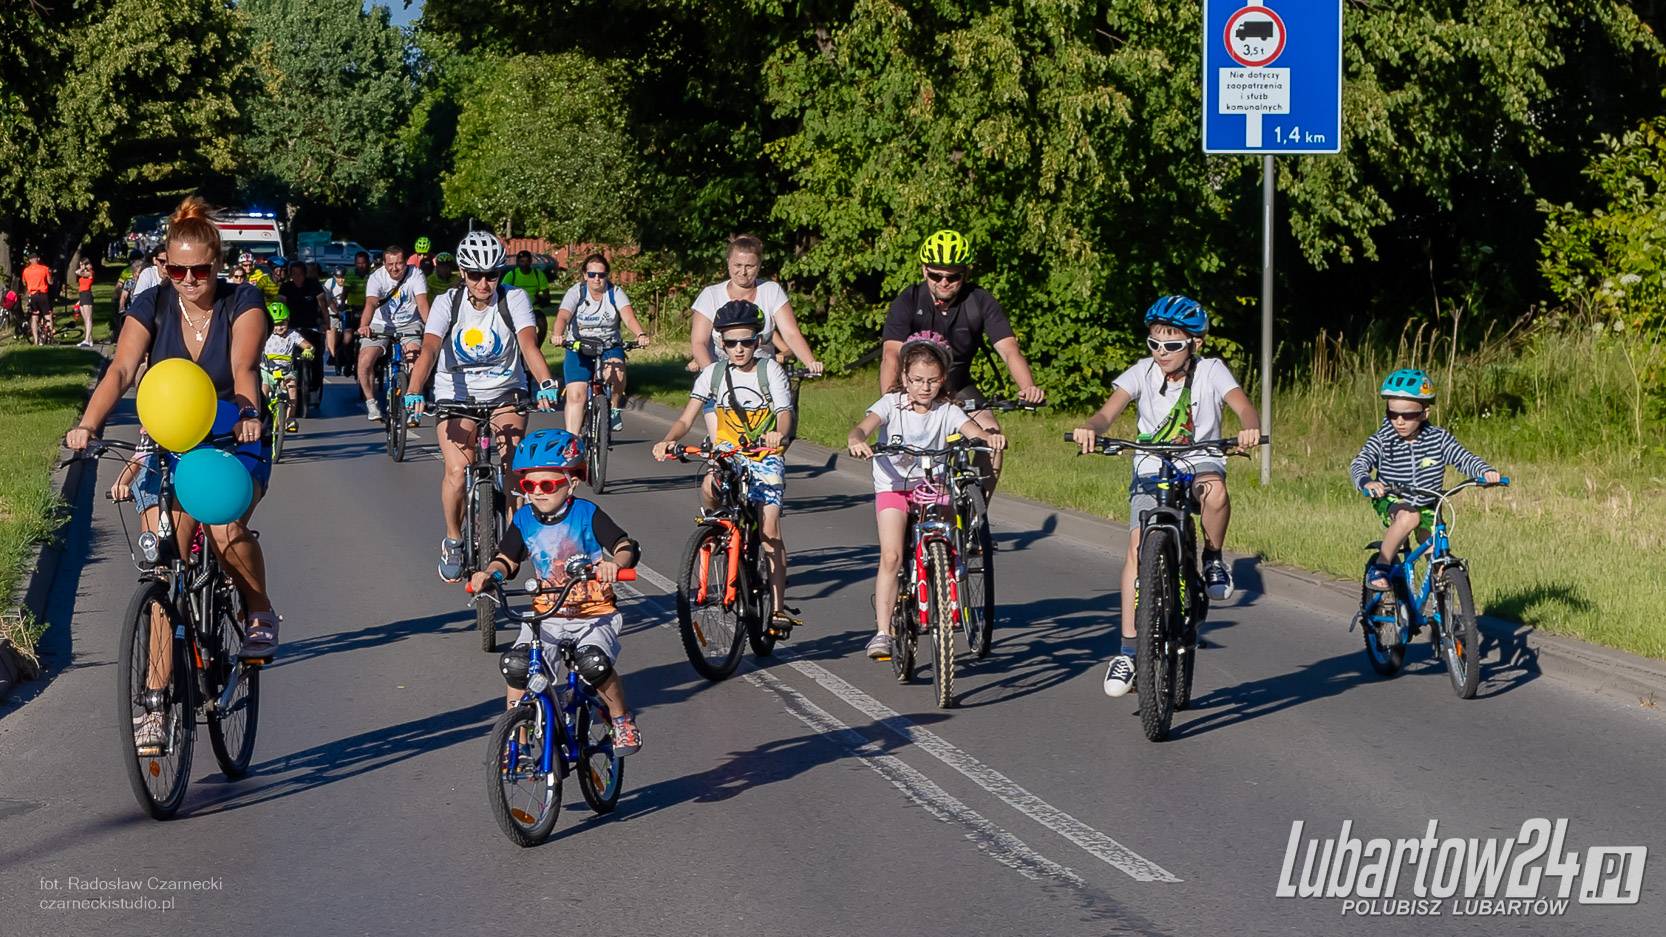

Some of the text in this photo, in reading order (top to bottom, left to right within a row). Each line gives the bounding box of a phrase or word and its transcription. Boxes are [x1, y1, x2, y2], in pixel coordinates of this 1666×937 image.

[1243, 44, 1258, 56] 3,5
[1230, 71, 1280, 80] Nie dotyczy
[1226, 83, 1283, 91] zaopatrzenia
[1226, 103, 1283, 112] komunalnych
[1274, 126, 1326, 144] 1,4 km
